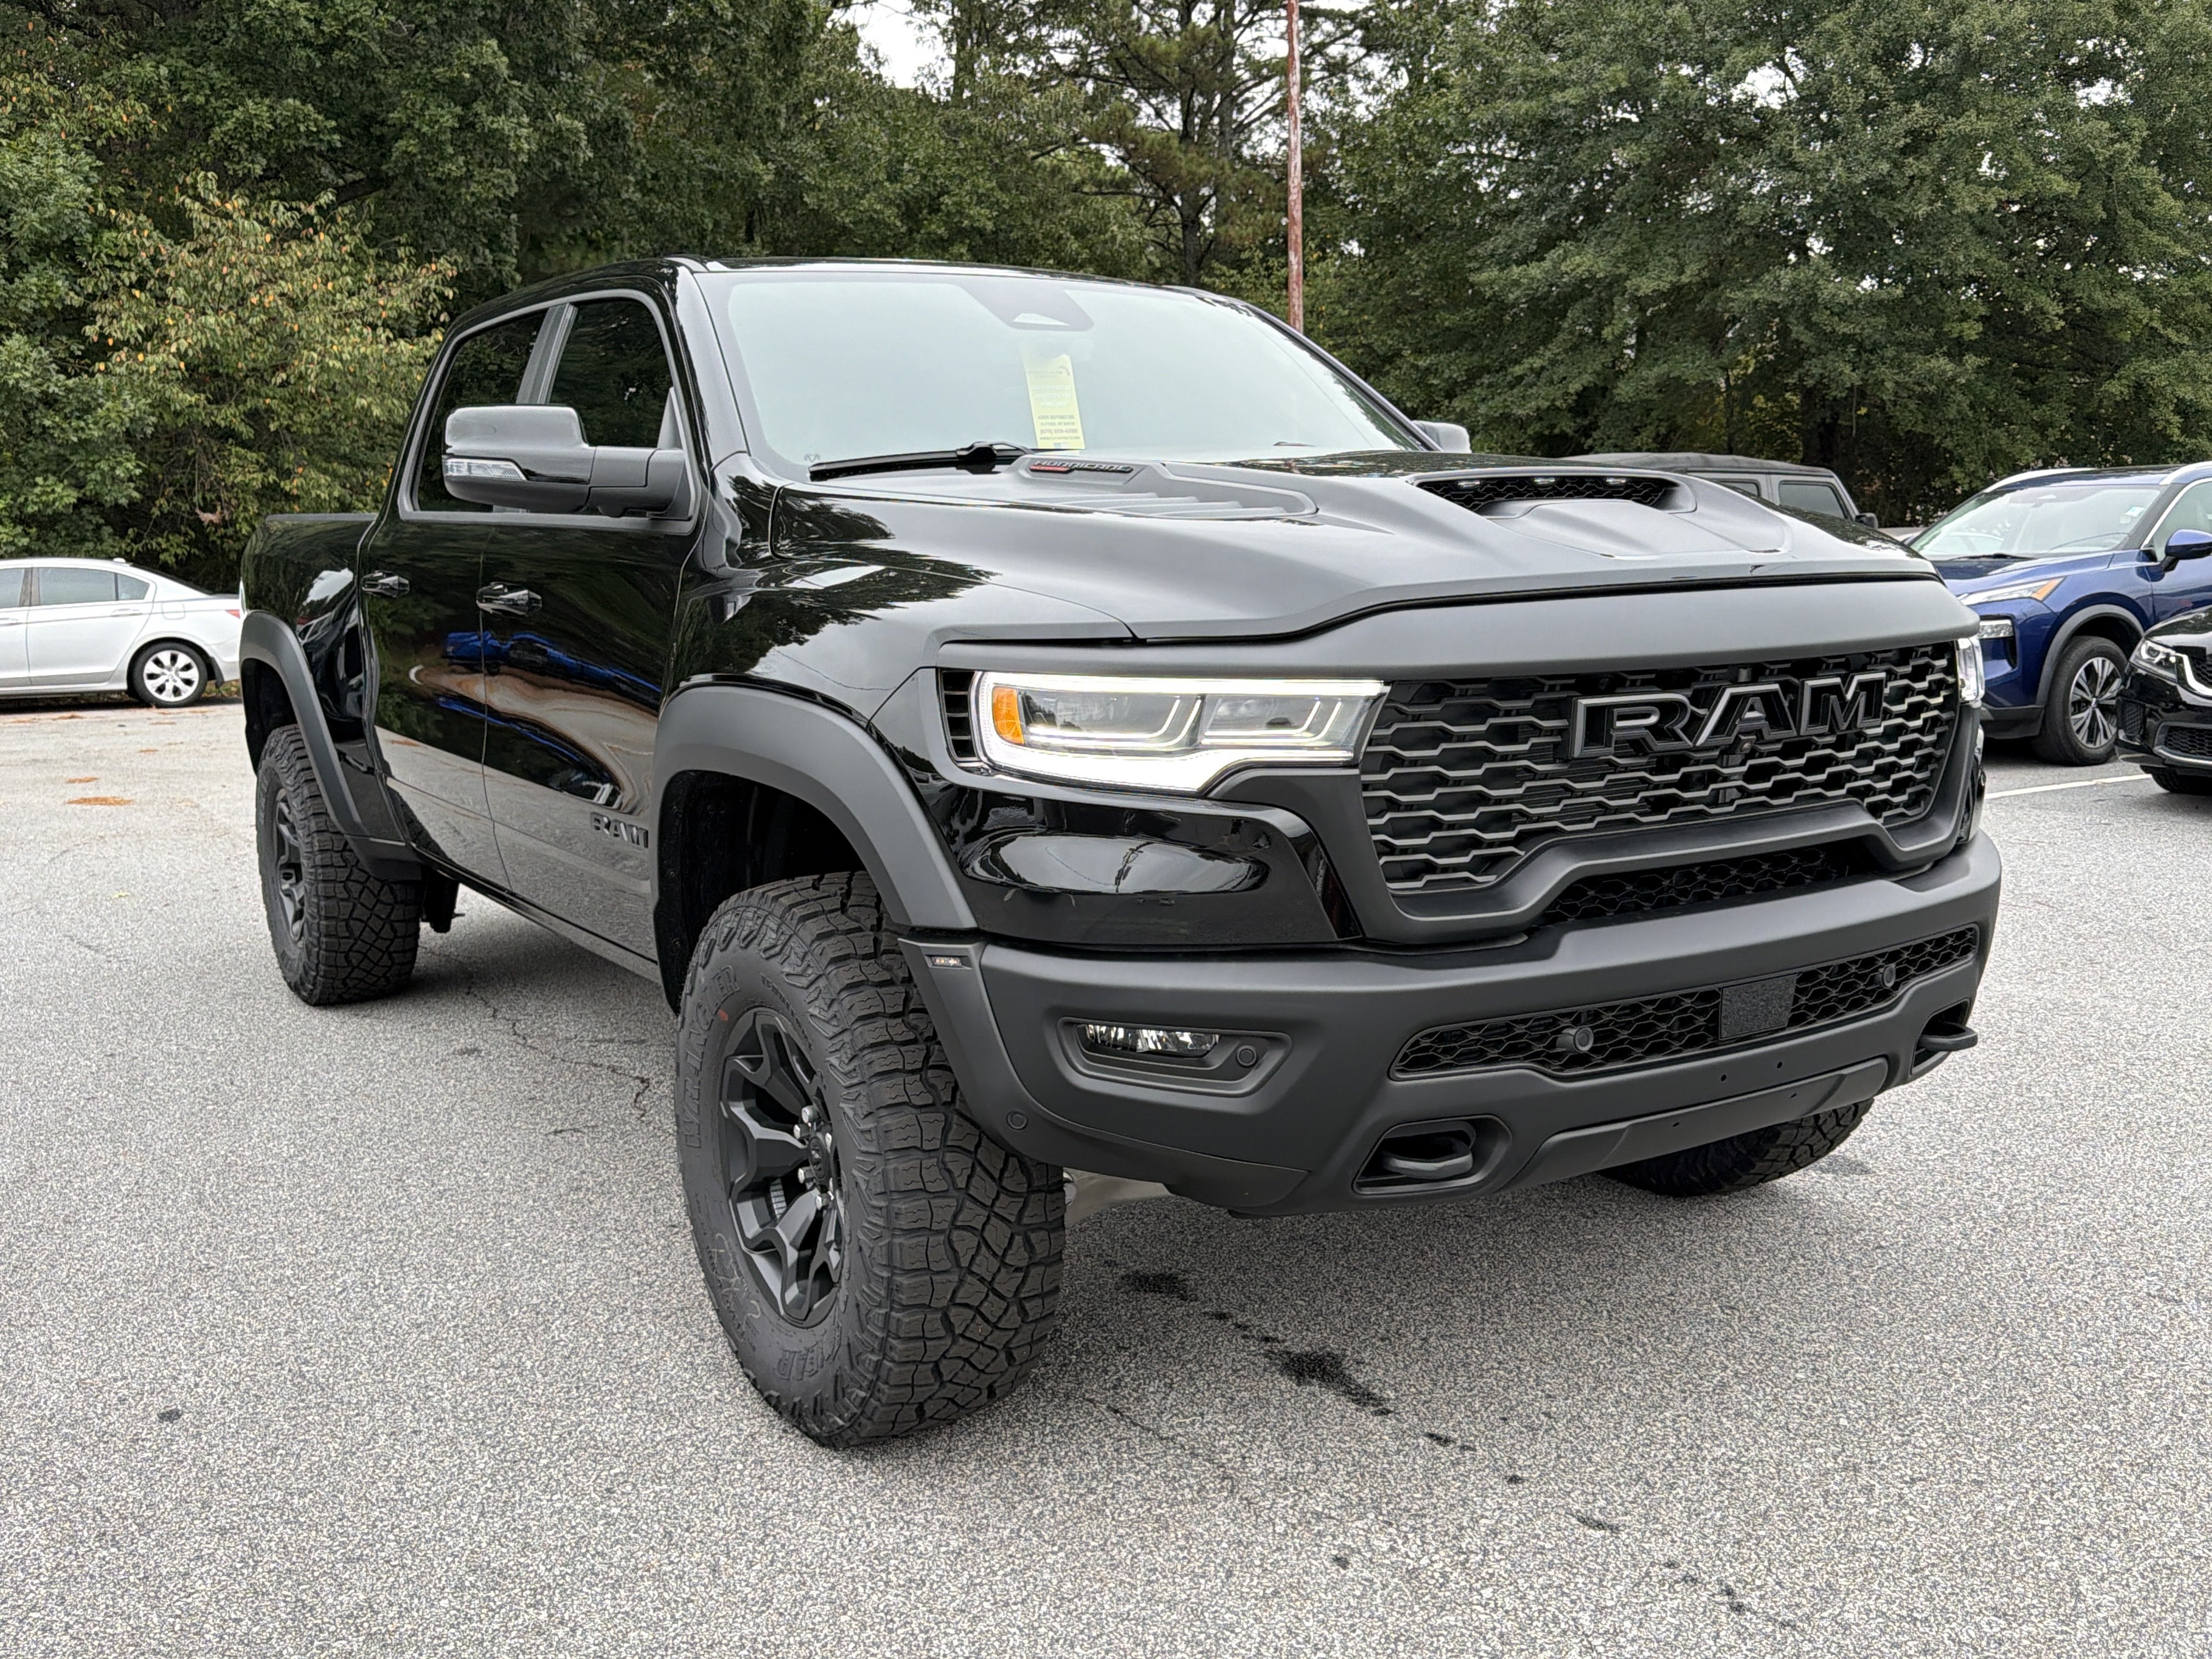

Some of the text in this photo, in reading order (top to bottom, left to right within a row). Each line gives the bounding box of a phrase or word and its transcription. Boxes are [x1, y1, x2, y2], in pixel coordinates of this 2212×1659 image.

[1034, 460, 1132, 473] HURRICANE
[1570, 672, 1887, 760] RAM
[590, 811, 648, 848] RAM
